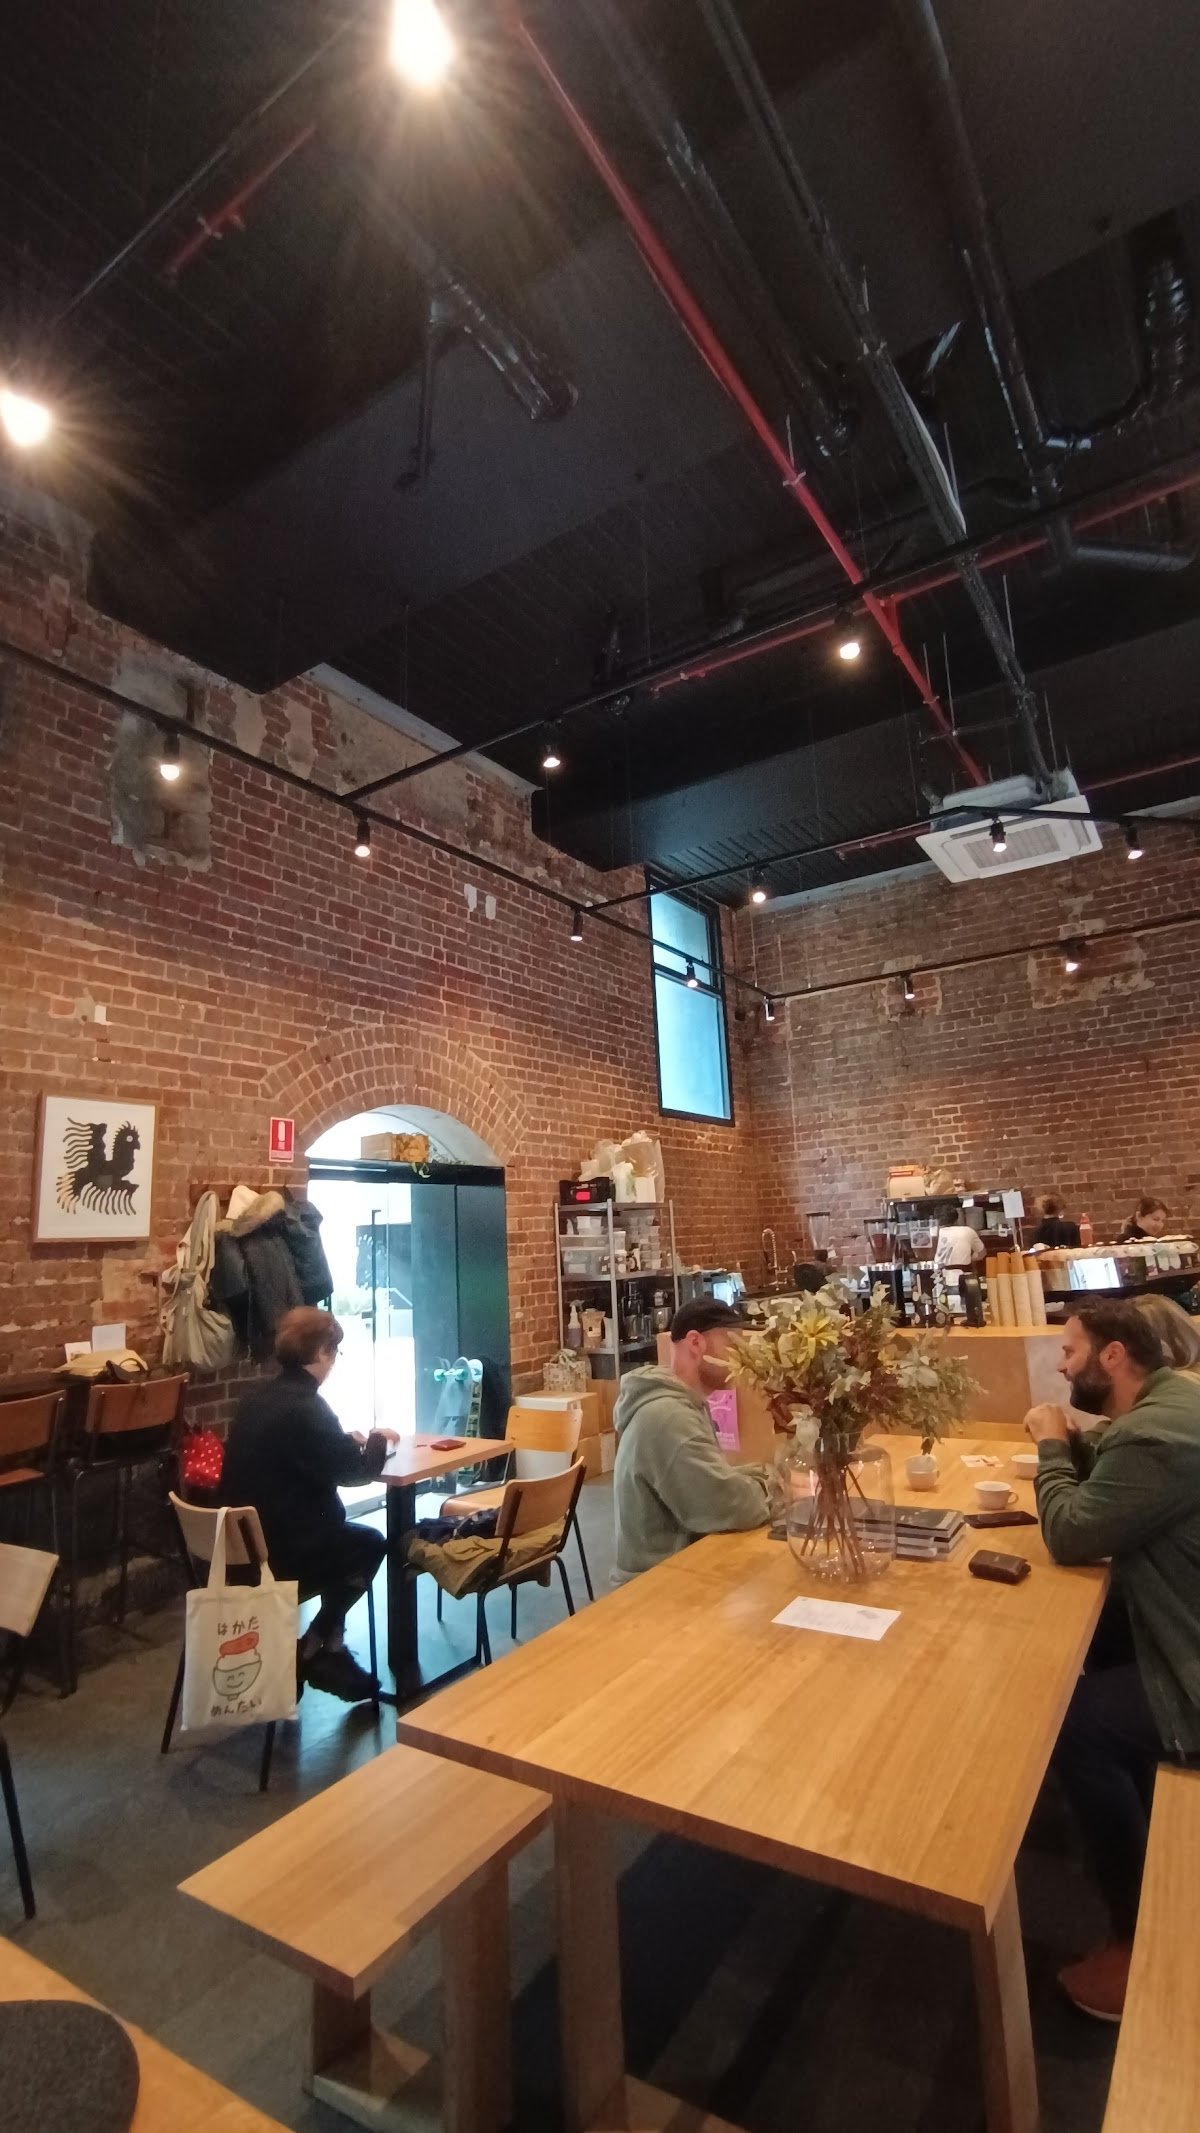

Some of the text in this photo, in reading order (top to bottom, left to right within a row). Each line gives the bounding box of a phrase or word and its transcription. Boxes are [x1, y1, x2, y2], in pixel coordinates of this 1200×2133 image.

[217, 1615, 260, 1636] はかた
[210, 1697, 263, 1718] めんたい
